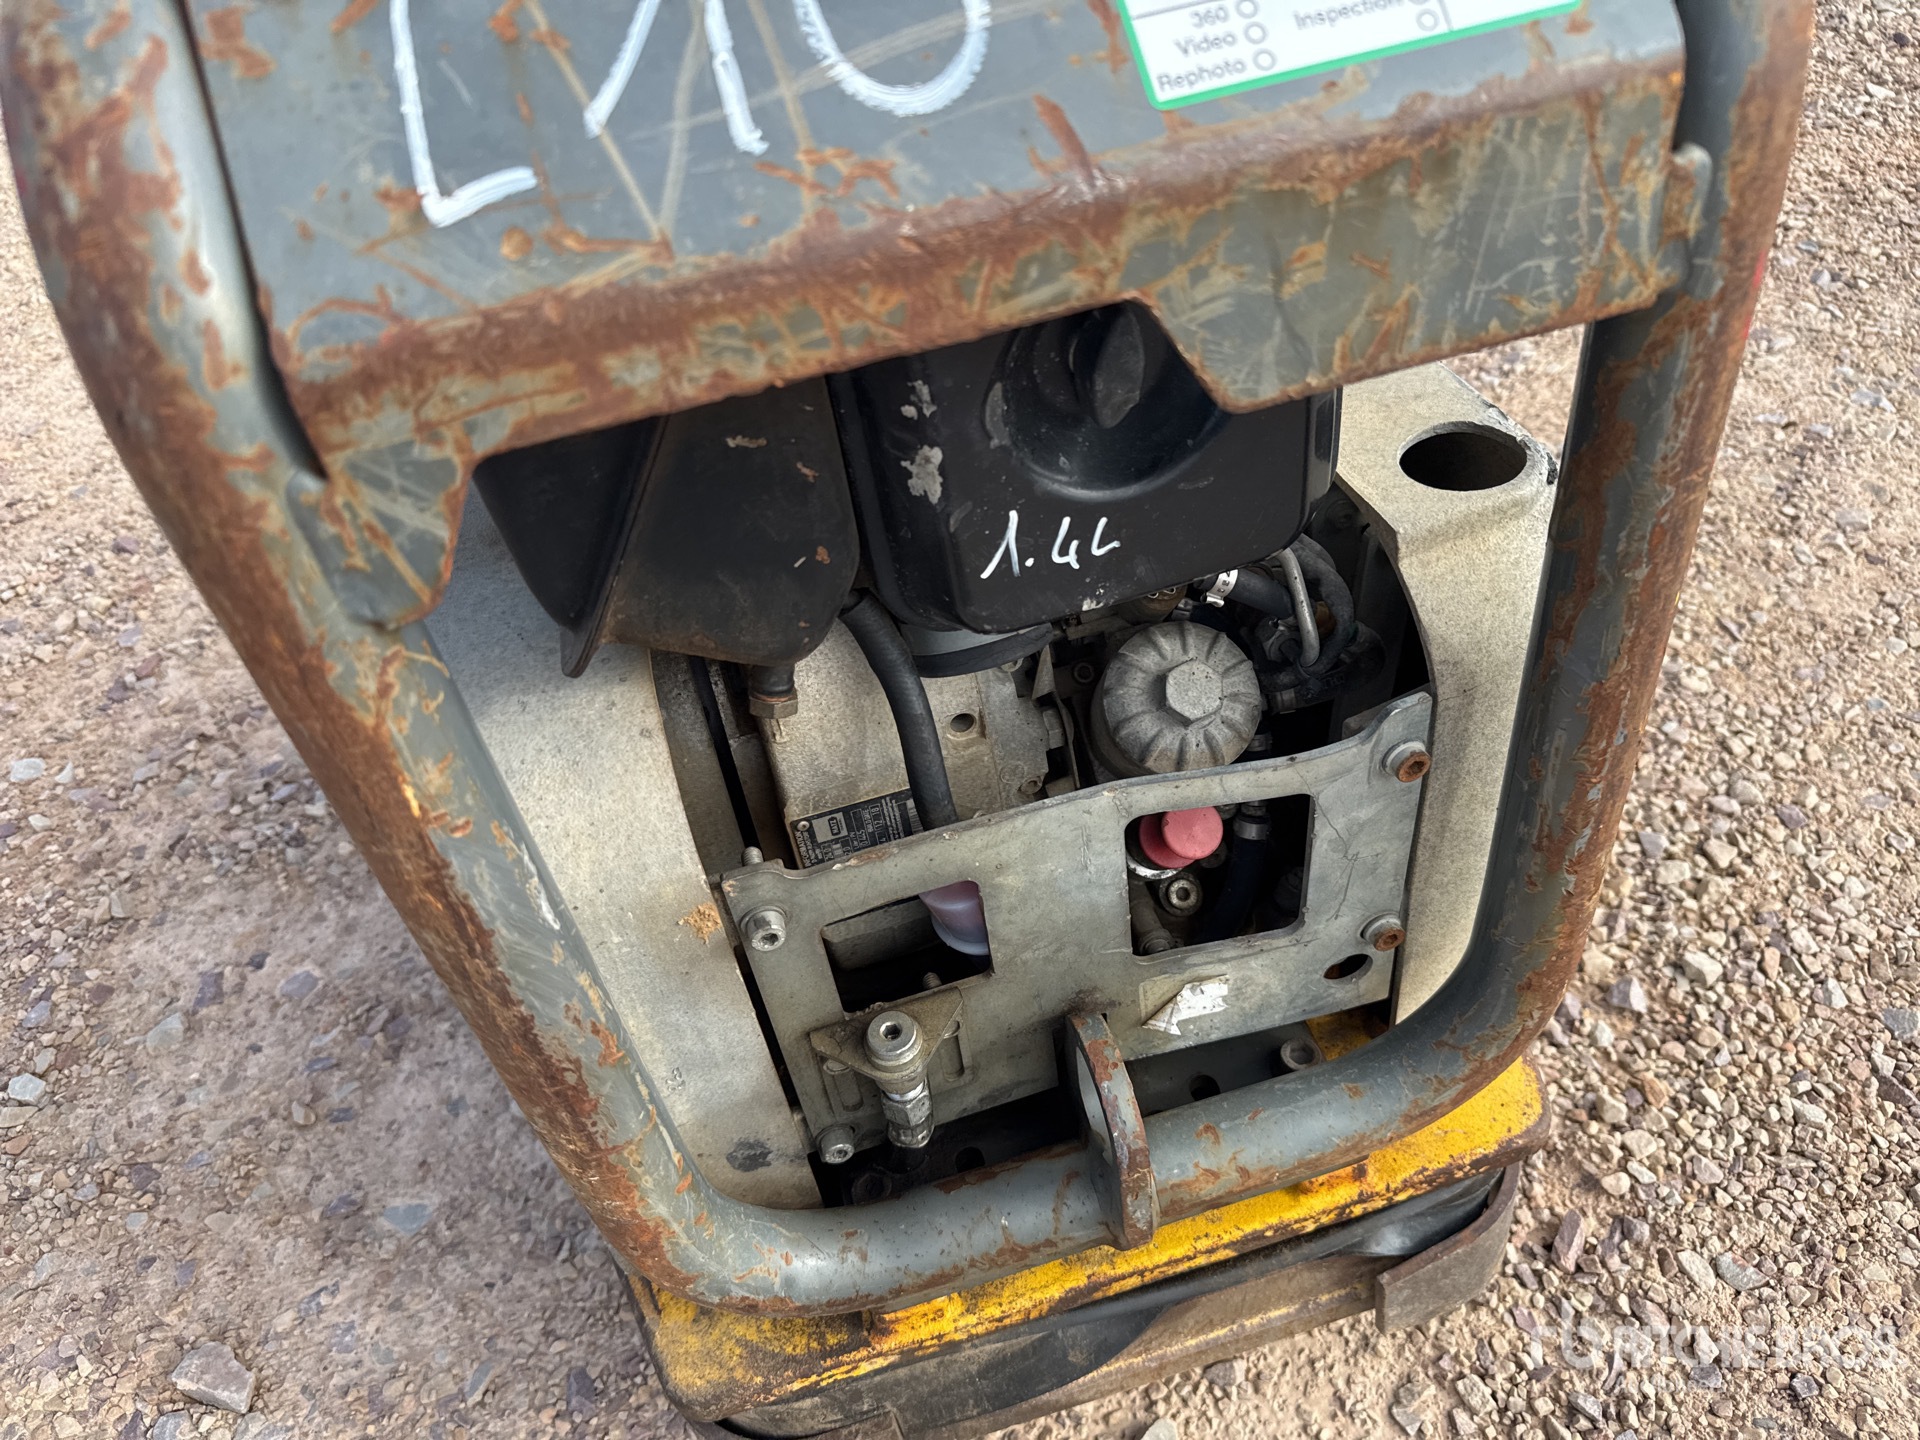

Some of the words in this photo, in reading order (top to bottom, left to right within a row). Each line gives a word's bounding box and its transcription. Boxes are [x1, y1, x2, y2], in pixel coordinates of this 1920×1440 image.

[1174, 32, 1238, 57] Video
[1158, 60, 1247, 91] Rephoto
[829, 818, 839, 835] HATZ
